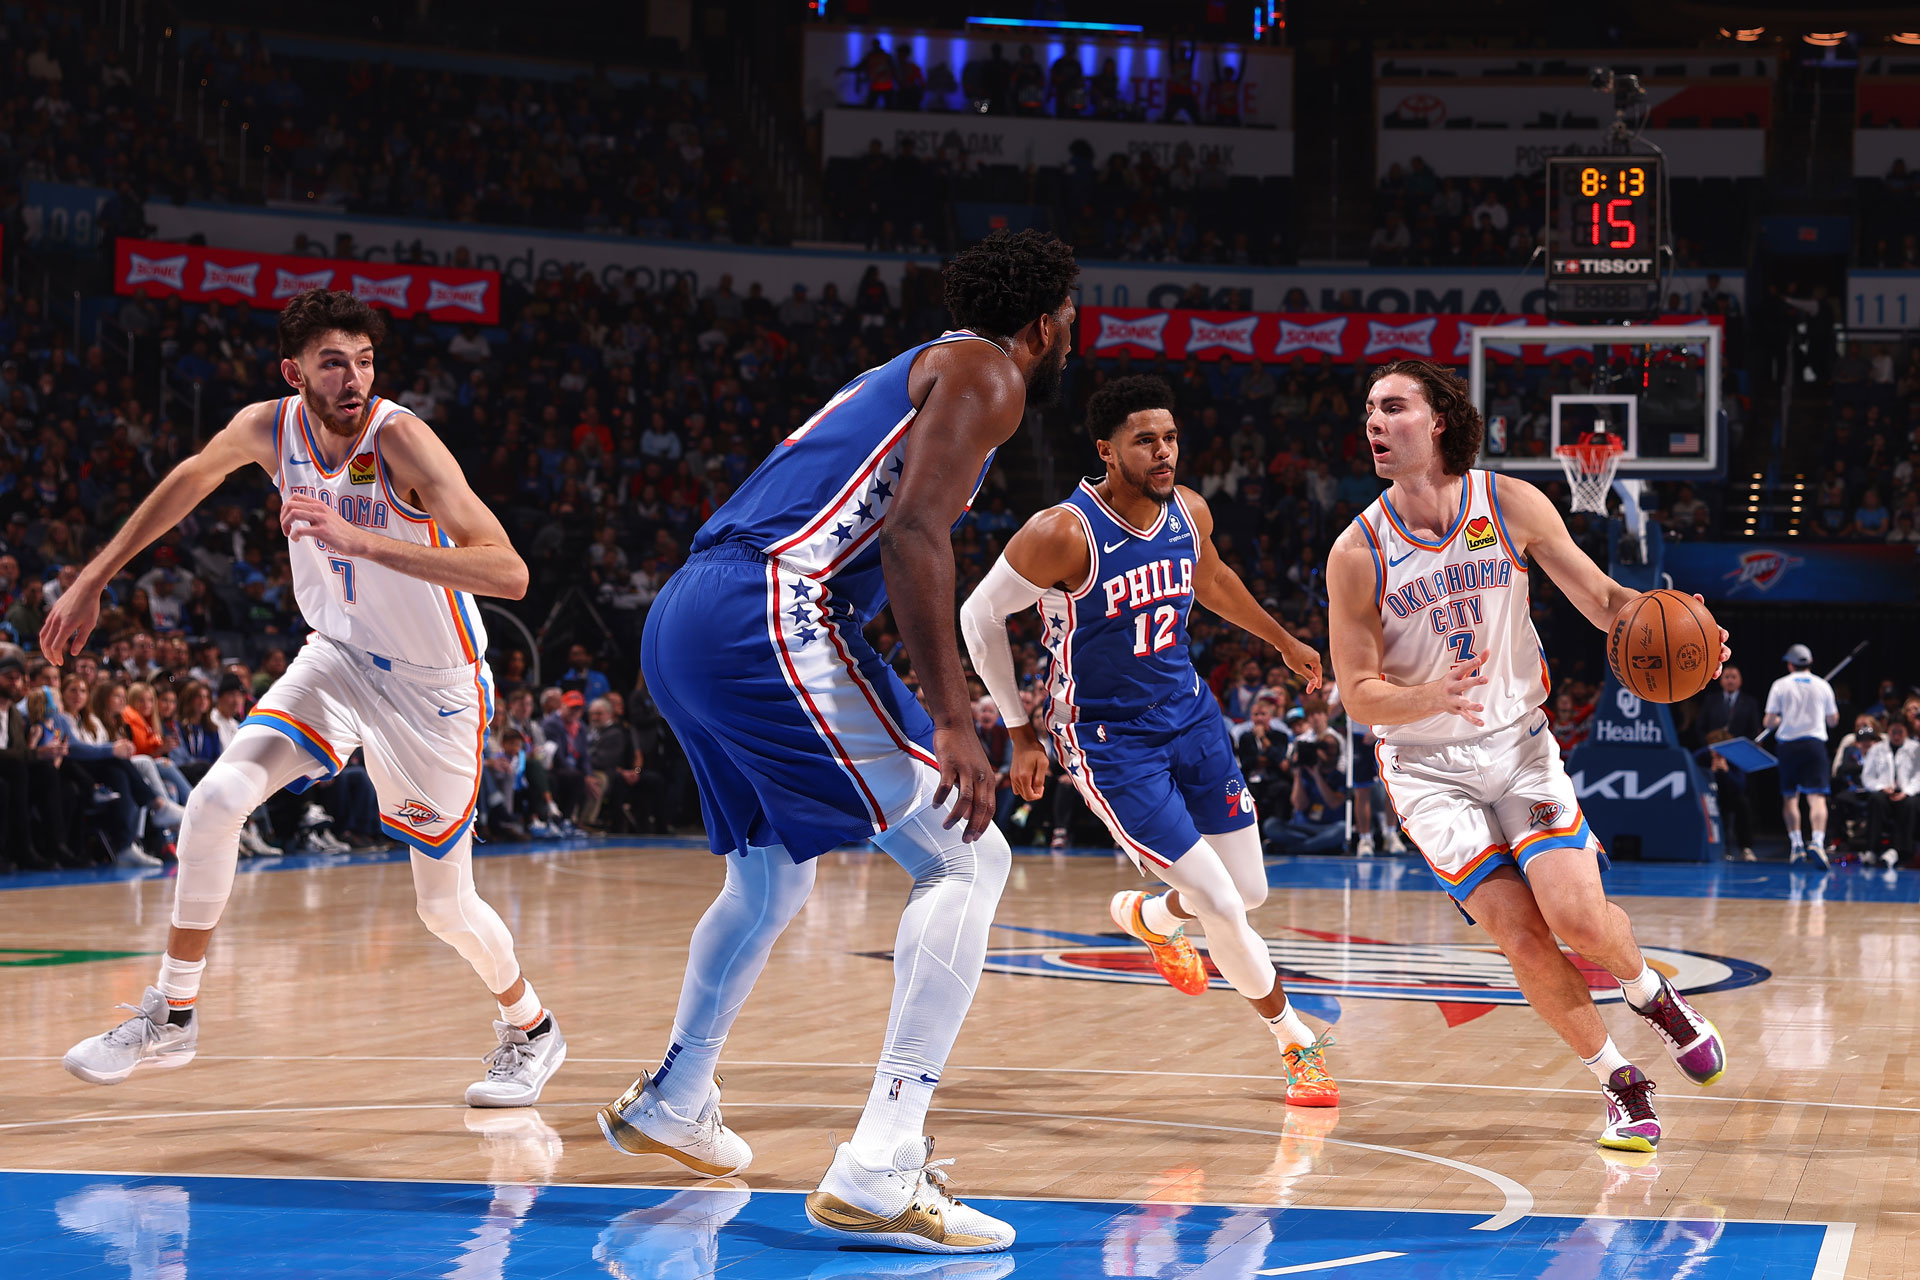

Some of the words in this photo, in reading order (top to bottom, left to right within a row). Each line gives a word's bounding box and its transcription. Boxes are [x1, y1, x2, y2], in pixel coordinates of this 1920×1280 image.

[1581, 167, 1646, 197] 8:13
[1591, 198, 1637, 249] 15
[1580, 258, 1653, 274] TISSOT
[1855, 293, 1907, 325] 111
[1105, 323, 1158, 341] SONIC
[1196, 326, 1248, 343] SONIC
[1285, 328, 1337, 344] SONIC
[1374, 329, 1427, 345] SONIC
[328, 556, 356, 604] 7
[1385, 558, 1513, 619] OKLAHOMA
[1430, 594, 1483, 635] CITY
[1133, 604, 1179, 657] 12
[1446, 630, 1480, 678] 3
[1596, 719, 1663, 743] Health
[1225, 787, 1253, 818] 76
